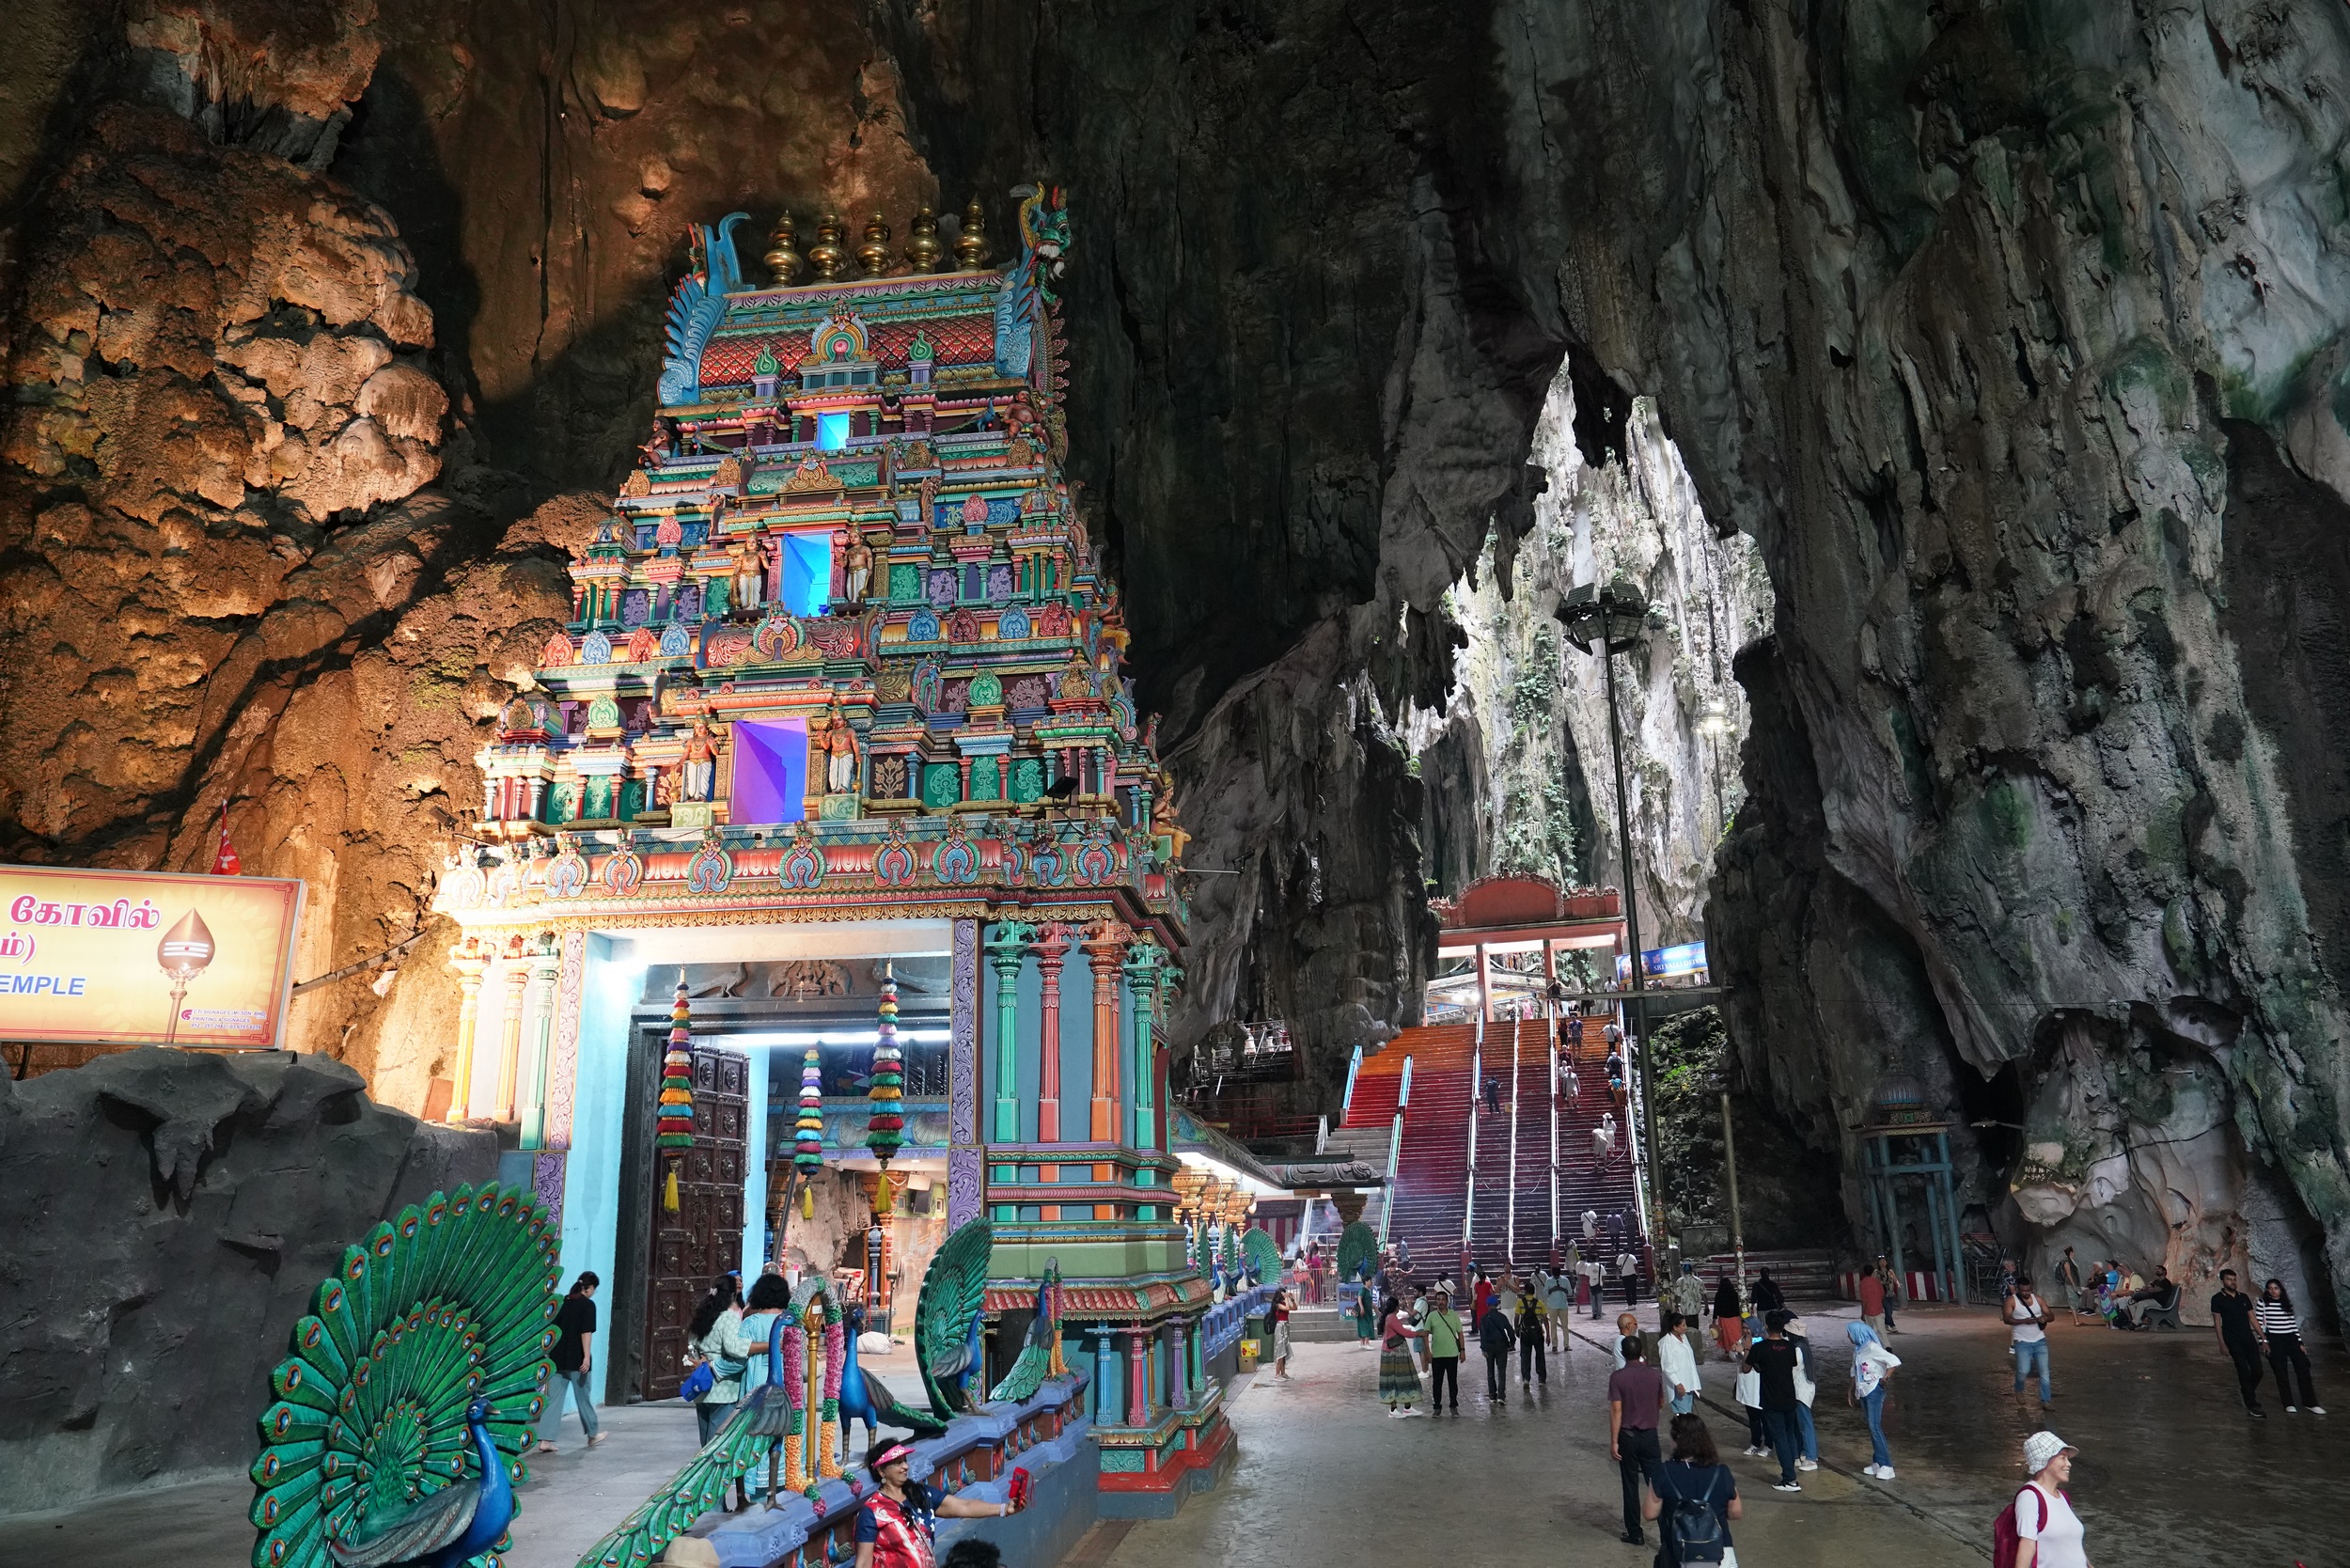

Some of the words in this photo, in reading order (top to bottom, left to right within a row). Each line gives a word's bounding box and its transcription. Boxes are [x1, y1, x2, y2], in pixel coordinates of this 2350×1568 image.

[10, 895, 160, 929] கோவில்
[1665, 961, 1682, 969] VALLI
[0, 975, 86, 996] EMPLE
